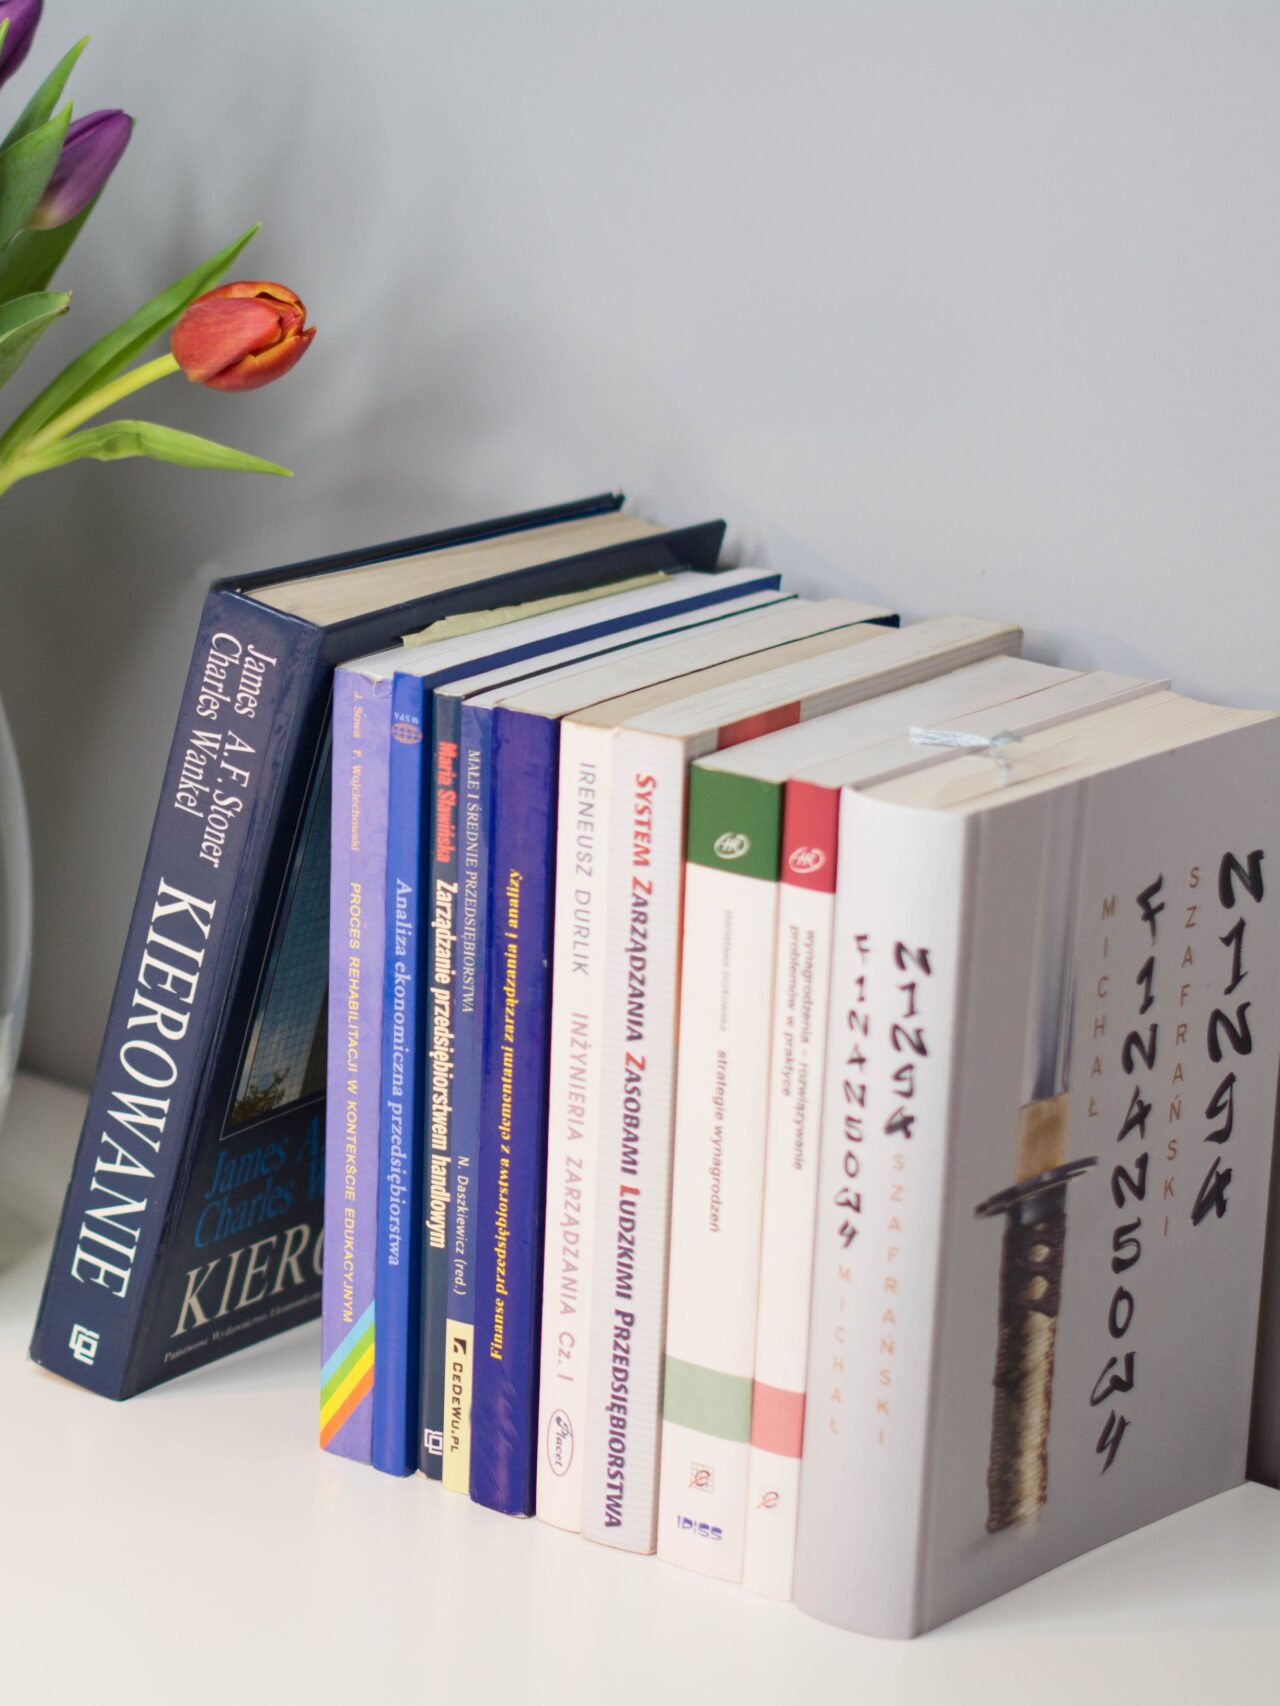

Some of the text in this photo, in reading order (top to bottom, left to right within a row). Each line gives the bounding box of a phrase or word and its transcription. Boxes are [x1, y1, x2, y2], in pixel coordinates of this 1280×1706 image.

[174, 632, 243, 818] Charles Wankel
[235, 644, 277, 719] James
[352, 705, 364, 738] Sowa
[394, 711, 419, 724] WSPA
[200, 790, 243, 869] Stoner
[436, 741, 458, 863] Maria Sławińska
[465, 802, 481, 867] ŚREDNIE
[466, 749, 481, 789] MAŁE
[505, 868, 523, 929] analizy
[571, 762, 597, 976] IRENEUSZ DURLIK
[461, 870, 478, 1014] PRZEDSIĘBIORSTWA
[503, 943, 519, 1042] zarządzania
[781, 925, 801, 1096] problemów w praktyce
[1087, 896, 1116, 1117] MICHAŁ
[70, 876, 217, 1299] KIEROWANIE
[342, 882, 362, 1323] PROCES REHABILITACJI W KONTEKŚCIE EDUKACYJNYM
[387, 878, 413, 1266] Analiza ekonomiczna przedsiębiorstwa
[426, 879, 458, 1249] Zarządzanie przedsiębiorstwem handlowym
[498, 1045, 514, 1141] elementami
[567, 1013, 592, 1141] INŻYNIERIA
[793, 930, 816, 1171] wynagrodzenia rozwiązywanie
[1163, 866, 1200, 1237] SZAFRAŃSKI
[500, 1144, 510, 1154] z
[604, 773, 657, 1528] SYSTEM ZARZĄDZANIA ZASOBAMI LUDZKIMI PRZEDSIĘBIORSTWA
[708, 1050, 728, 1233] strategie wynagrodzeń
[193, 1177, 298, 1249] Charles
[452, 1155, 470, 1296] N. Daszkiewicz (red.)
[493, 1157, 511, 1296] przedsiębiorstwa
[558, 1155, 583, 1315] ZARZĄDZANIA
[489, 1297, 505, 1361] Finanse
[829, 1265, 851, 1434] MICHAŁ
